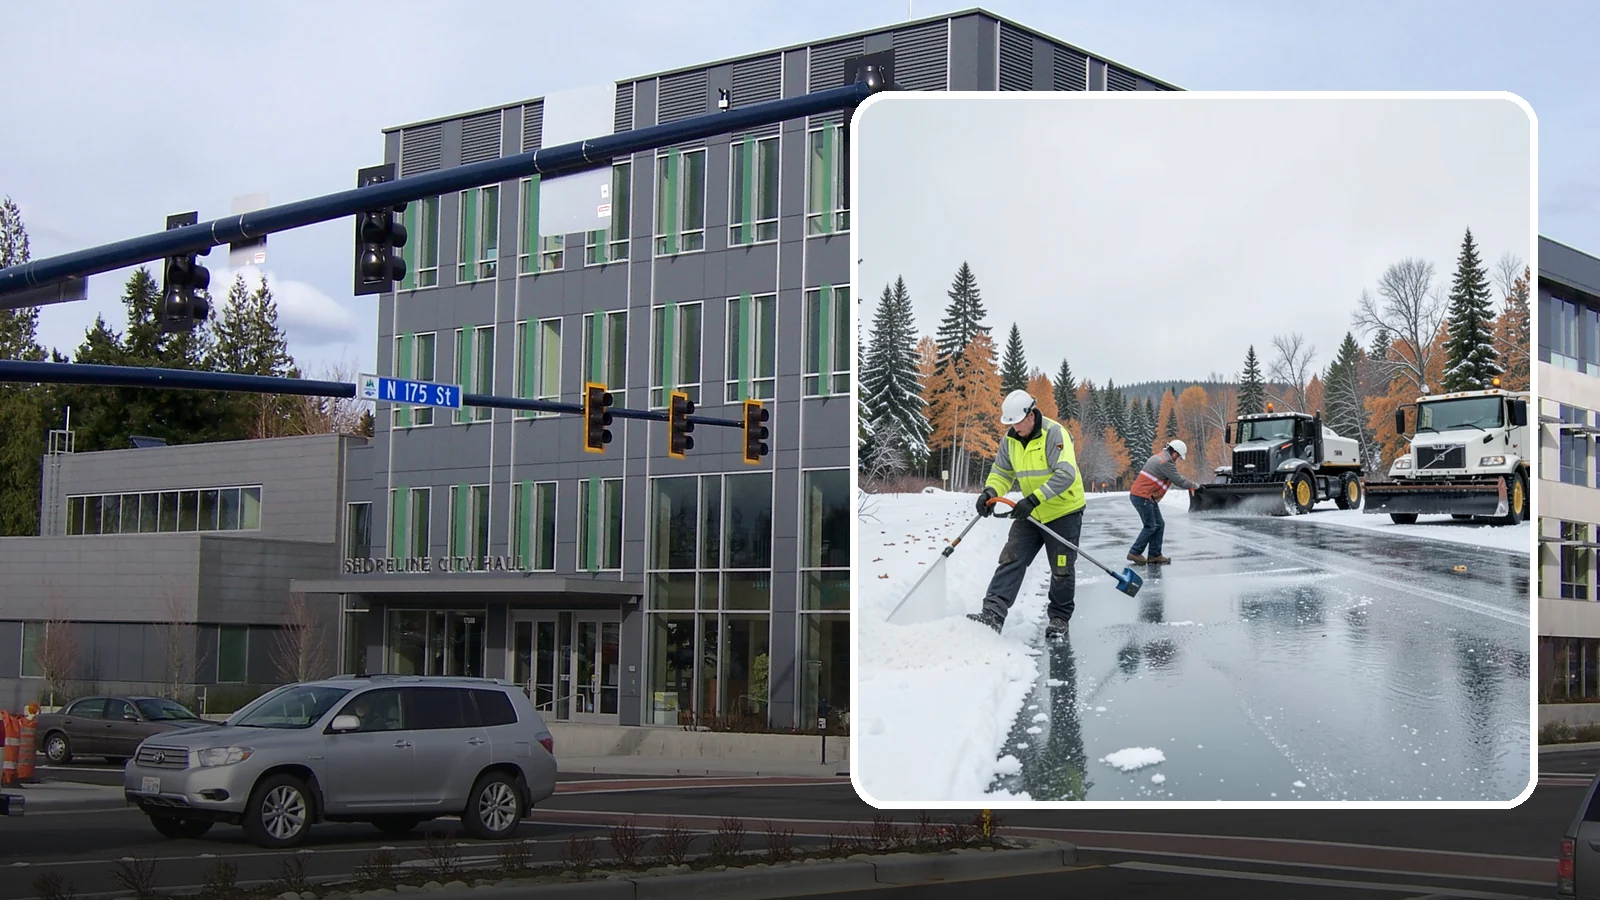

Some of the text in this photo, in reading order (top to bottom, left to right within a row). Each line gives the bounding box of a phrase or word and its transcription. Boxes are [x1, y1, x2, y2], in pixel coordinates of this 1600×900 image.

[387, 380, 451, 405] N 175 St
[344, 556, 525, 574] SHORELINE CITY HALL
